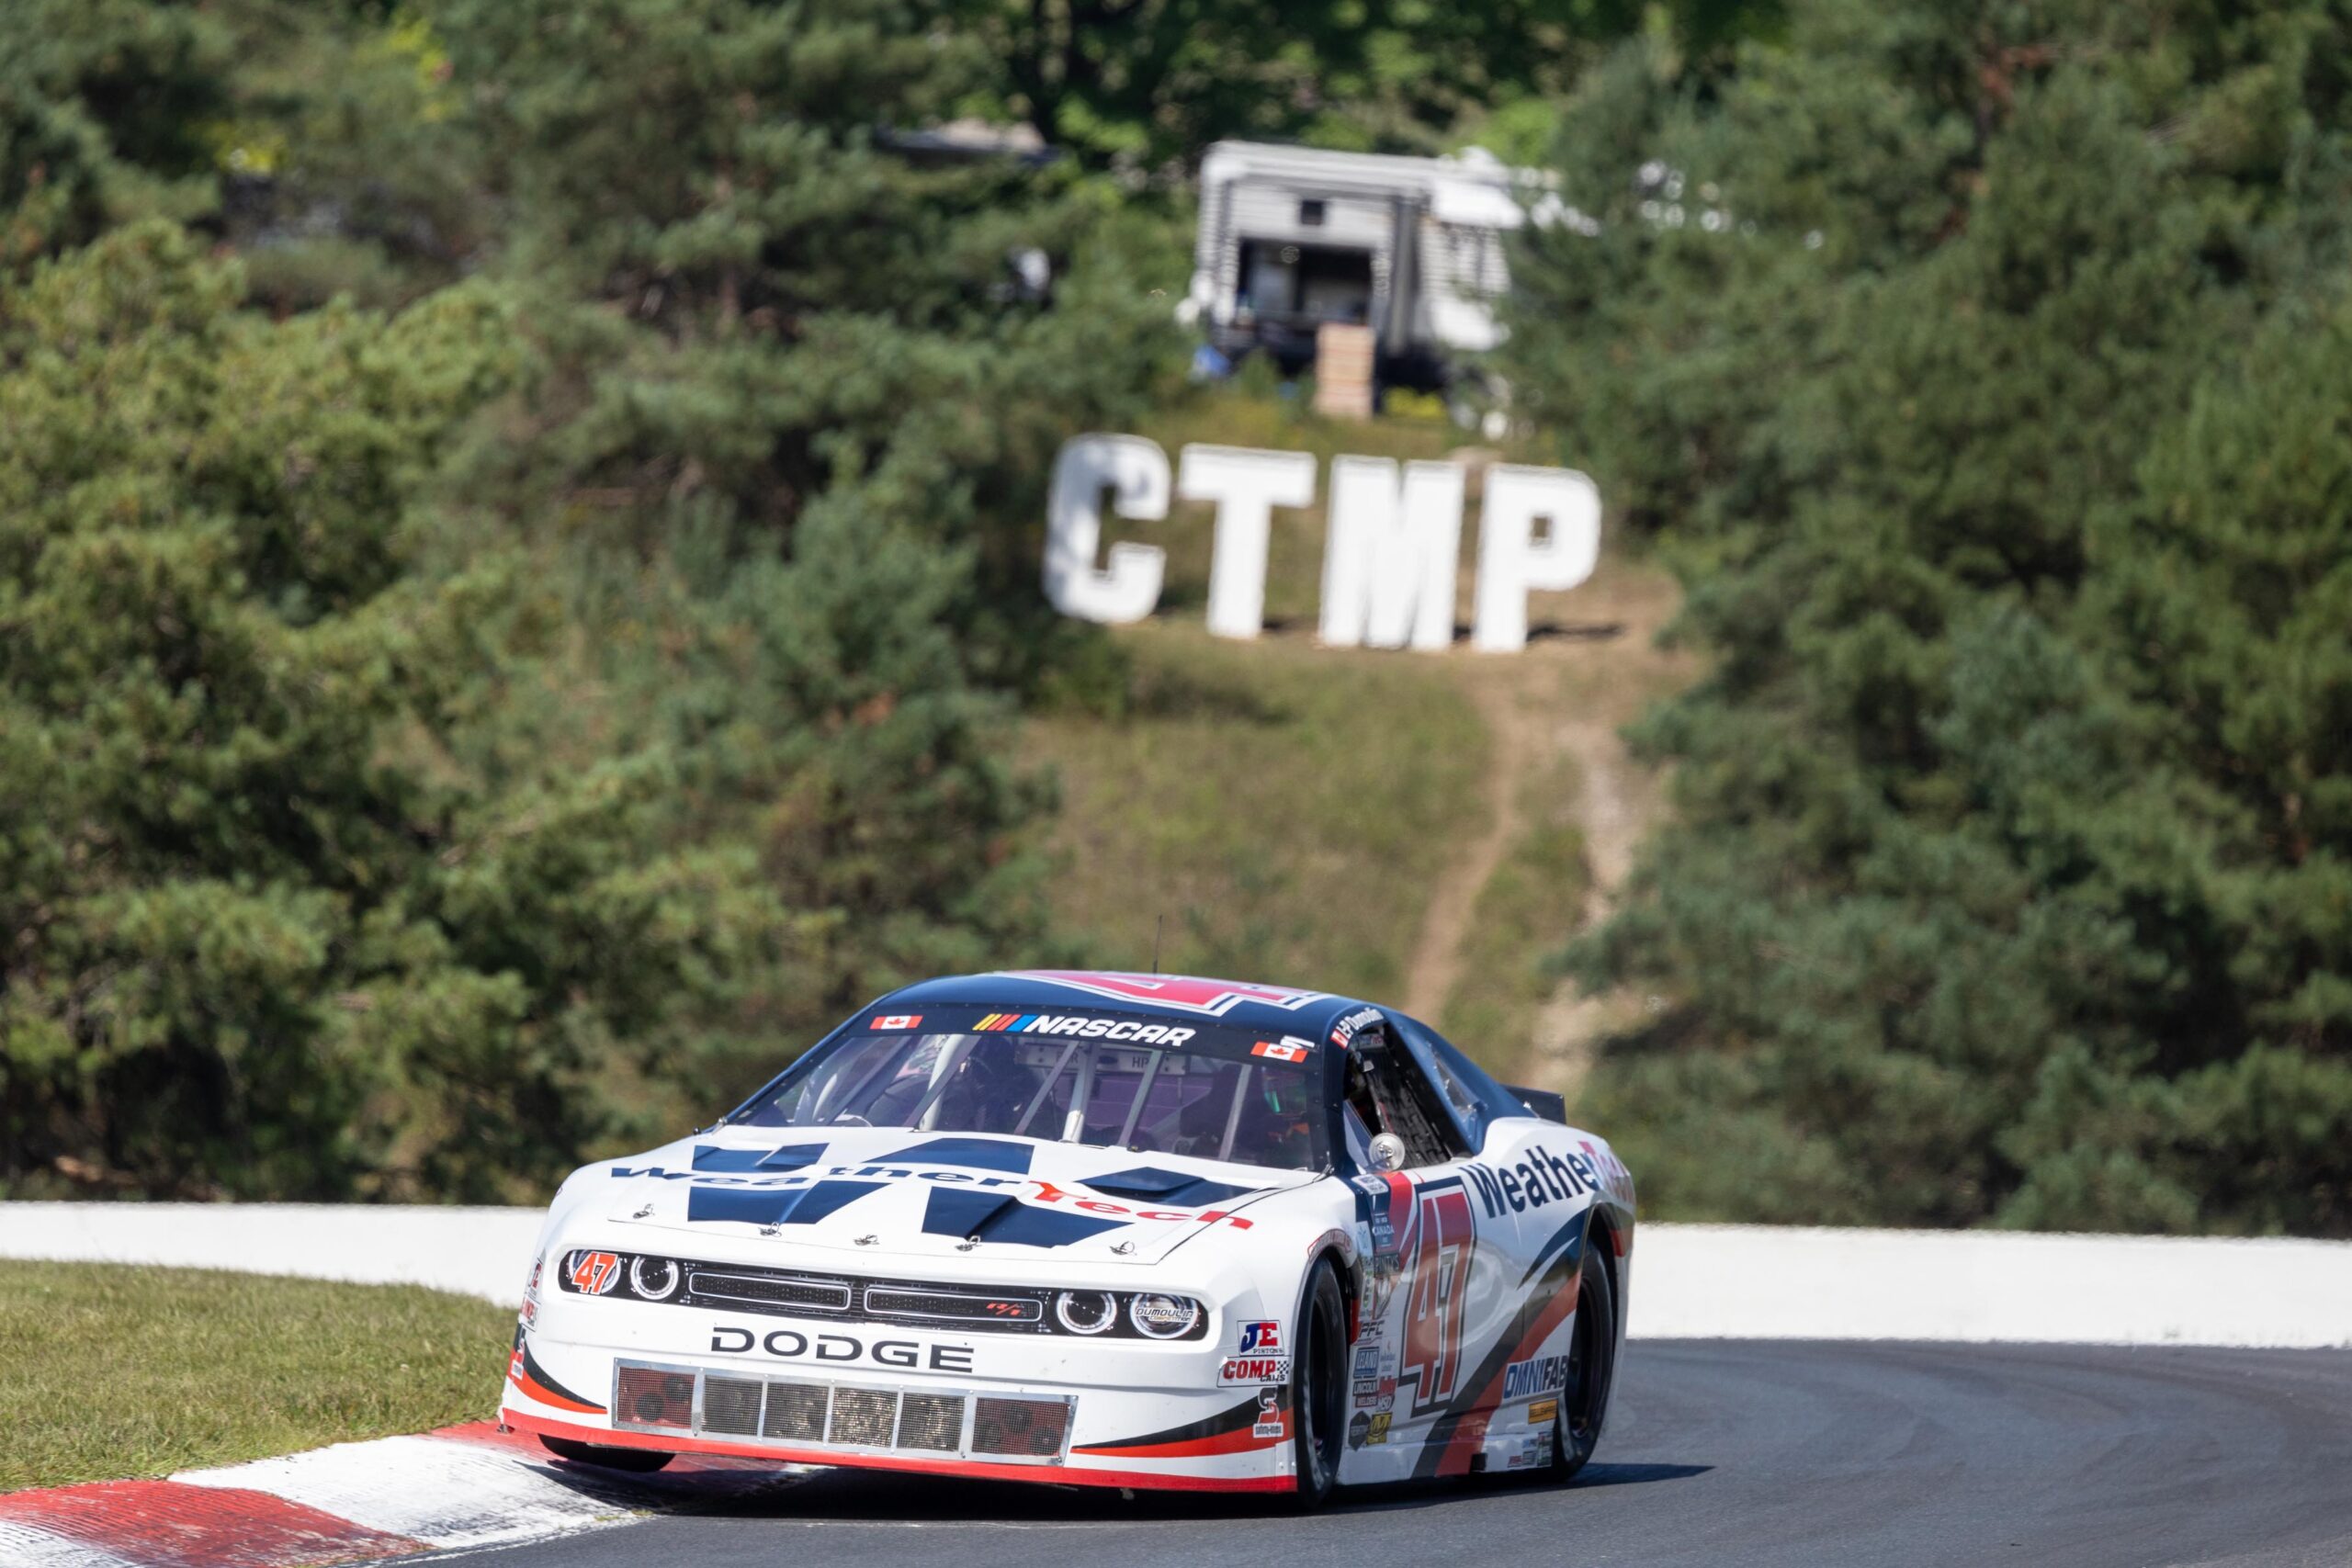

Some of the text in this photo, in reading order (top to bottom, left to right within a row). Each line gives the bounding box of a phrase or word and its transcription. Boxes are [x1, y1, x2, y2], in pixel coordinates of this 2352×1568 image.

[1044, 433, 1600, 653] CTMP
[1023, 1015, 1196, 1047] NASCAR
[611, 1167, 1254, 1231] WeatherTech
[571, 1251, 618, 1295] 47
[1136, 1308, 1193, 1318] DUMOULIN
[1401, 1183, 1474, 1408] 47
[711, 1326, 975, 1373] DODGE
[1240, 1323, 1278, 1353] JE
[1223, 1359, 1276, 1380] COMP
[1353, 1381, 1377, 1394] LINCOLN
